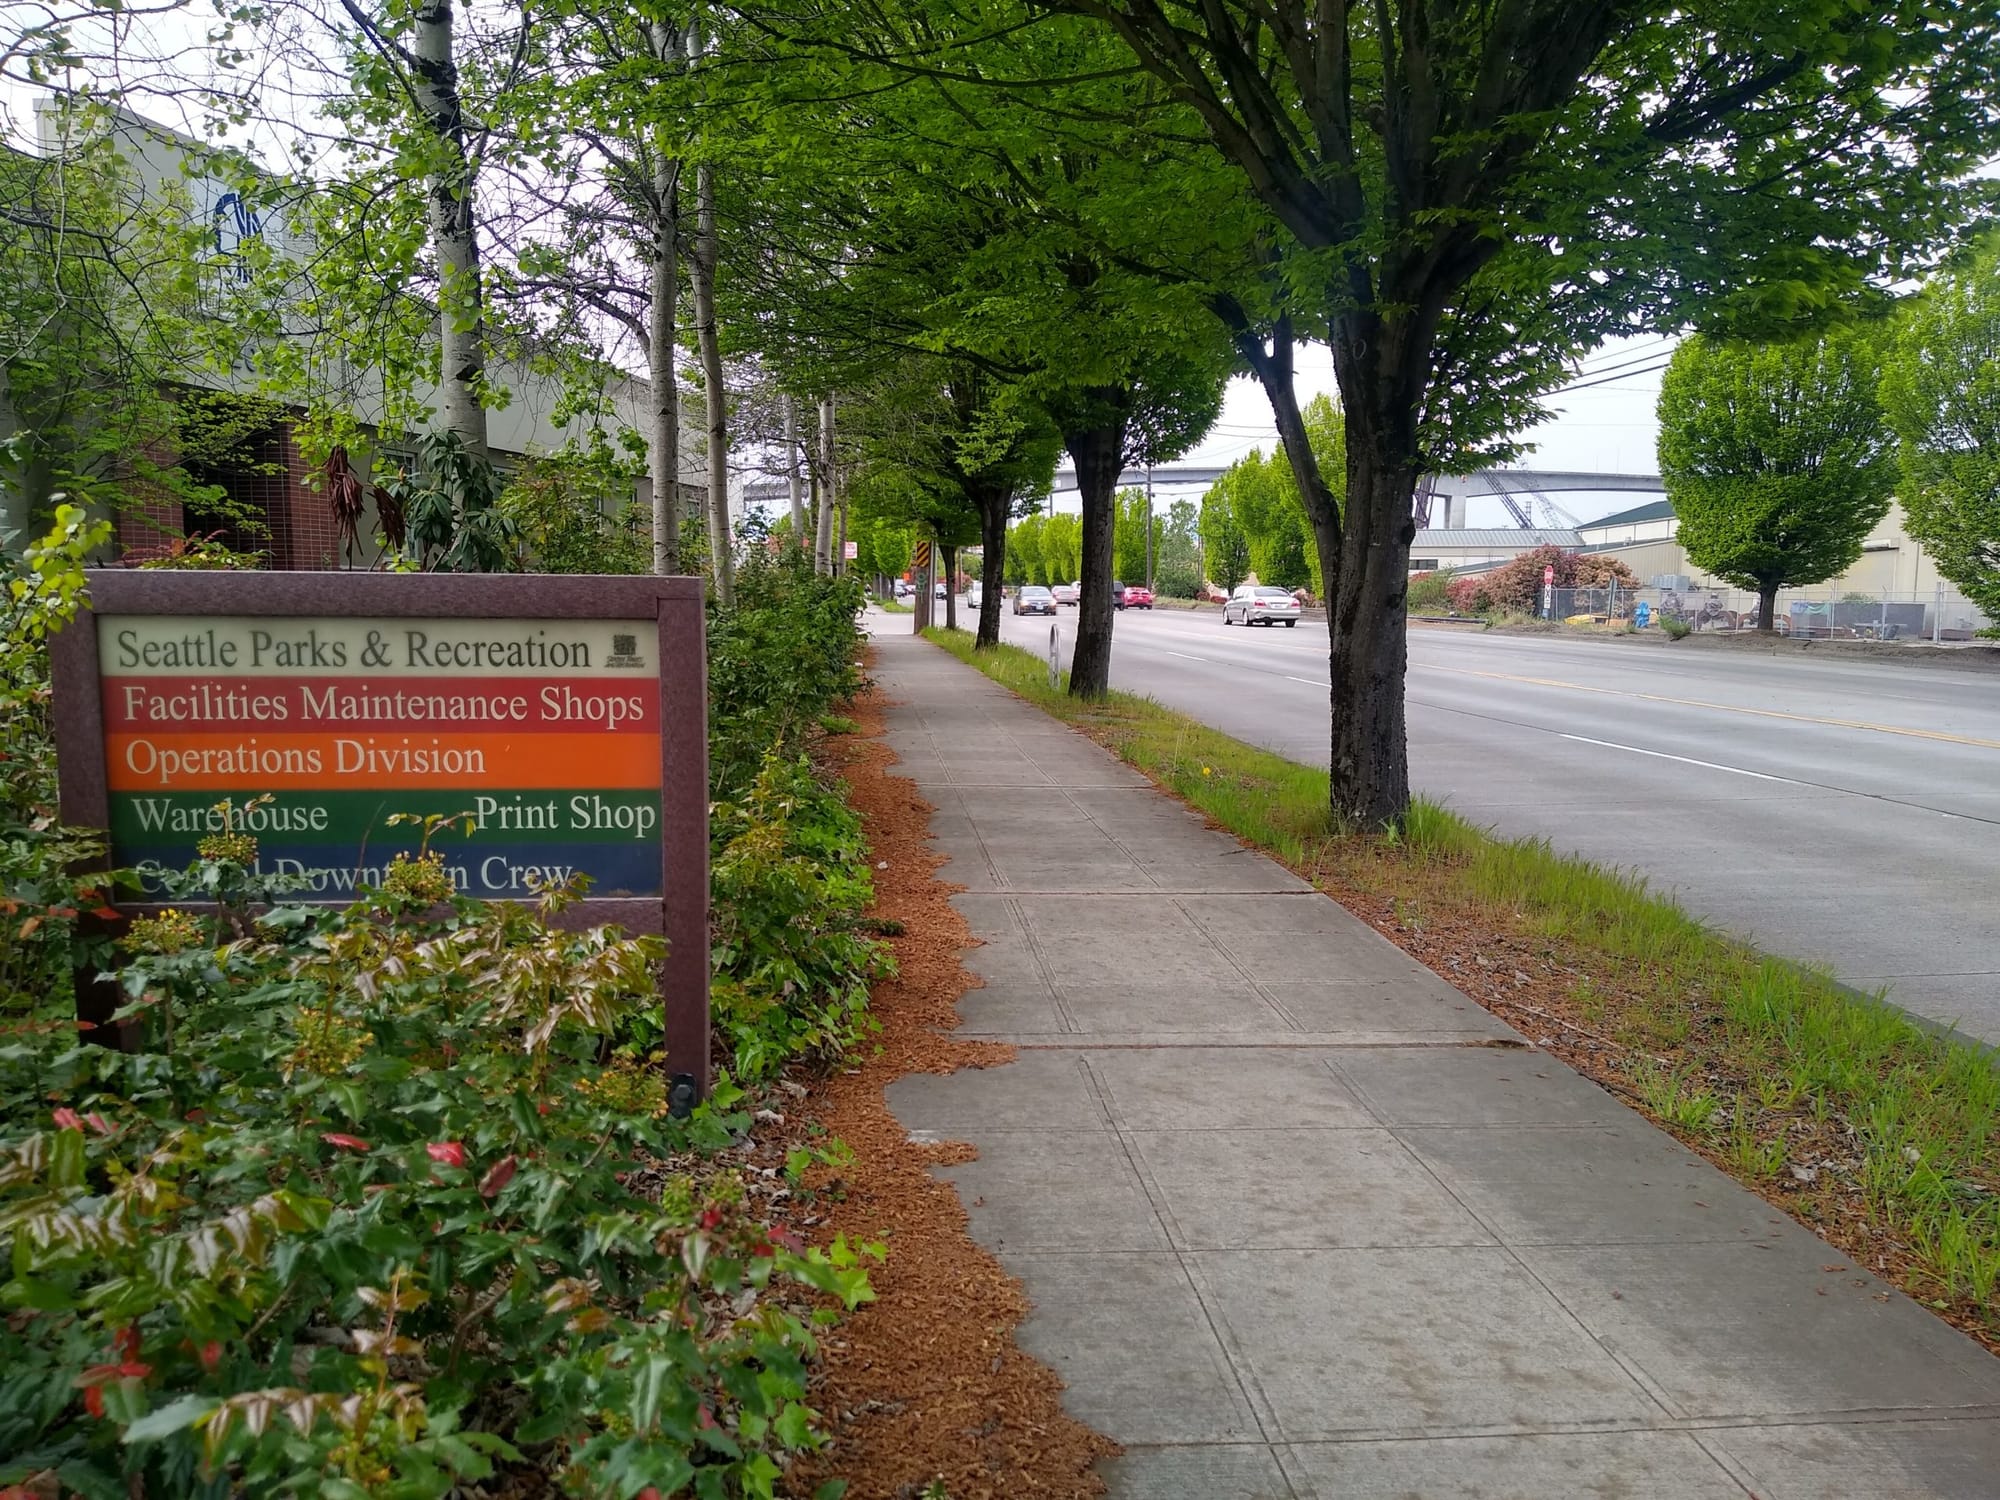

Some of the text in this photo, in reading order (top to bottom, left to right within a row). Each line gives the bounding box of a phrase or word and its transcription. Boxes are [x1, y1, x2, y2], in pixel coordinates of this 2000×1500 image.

[117, 629, 592, 668] Seattle Parks & Recreation
[122, 684, 645, 730] Facilities Maintenance Shops
[126, 738, 487, 784] Operations Division
[131, 796, 329, 832] Warehouse
[473, 795, 656, 838] Print Shop
[480, 856, 574, 890] Crew
